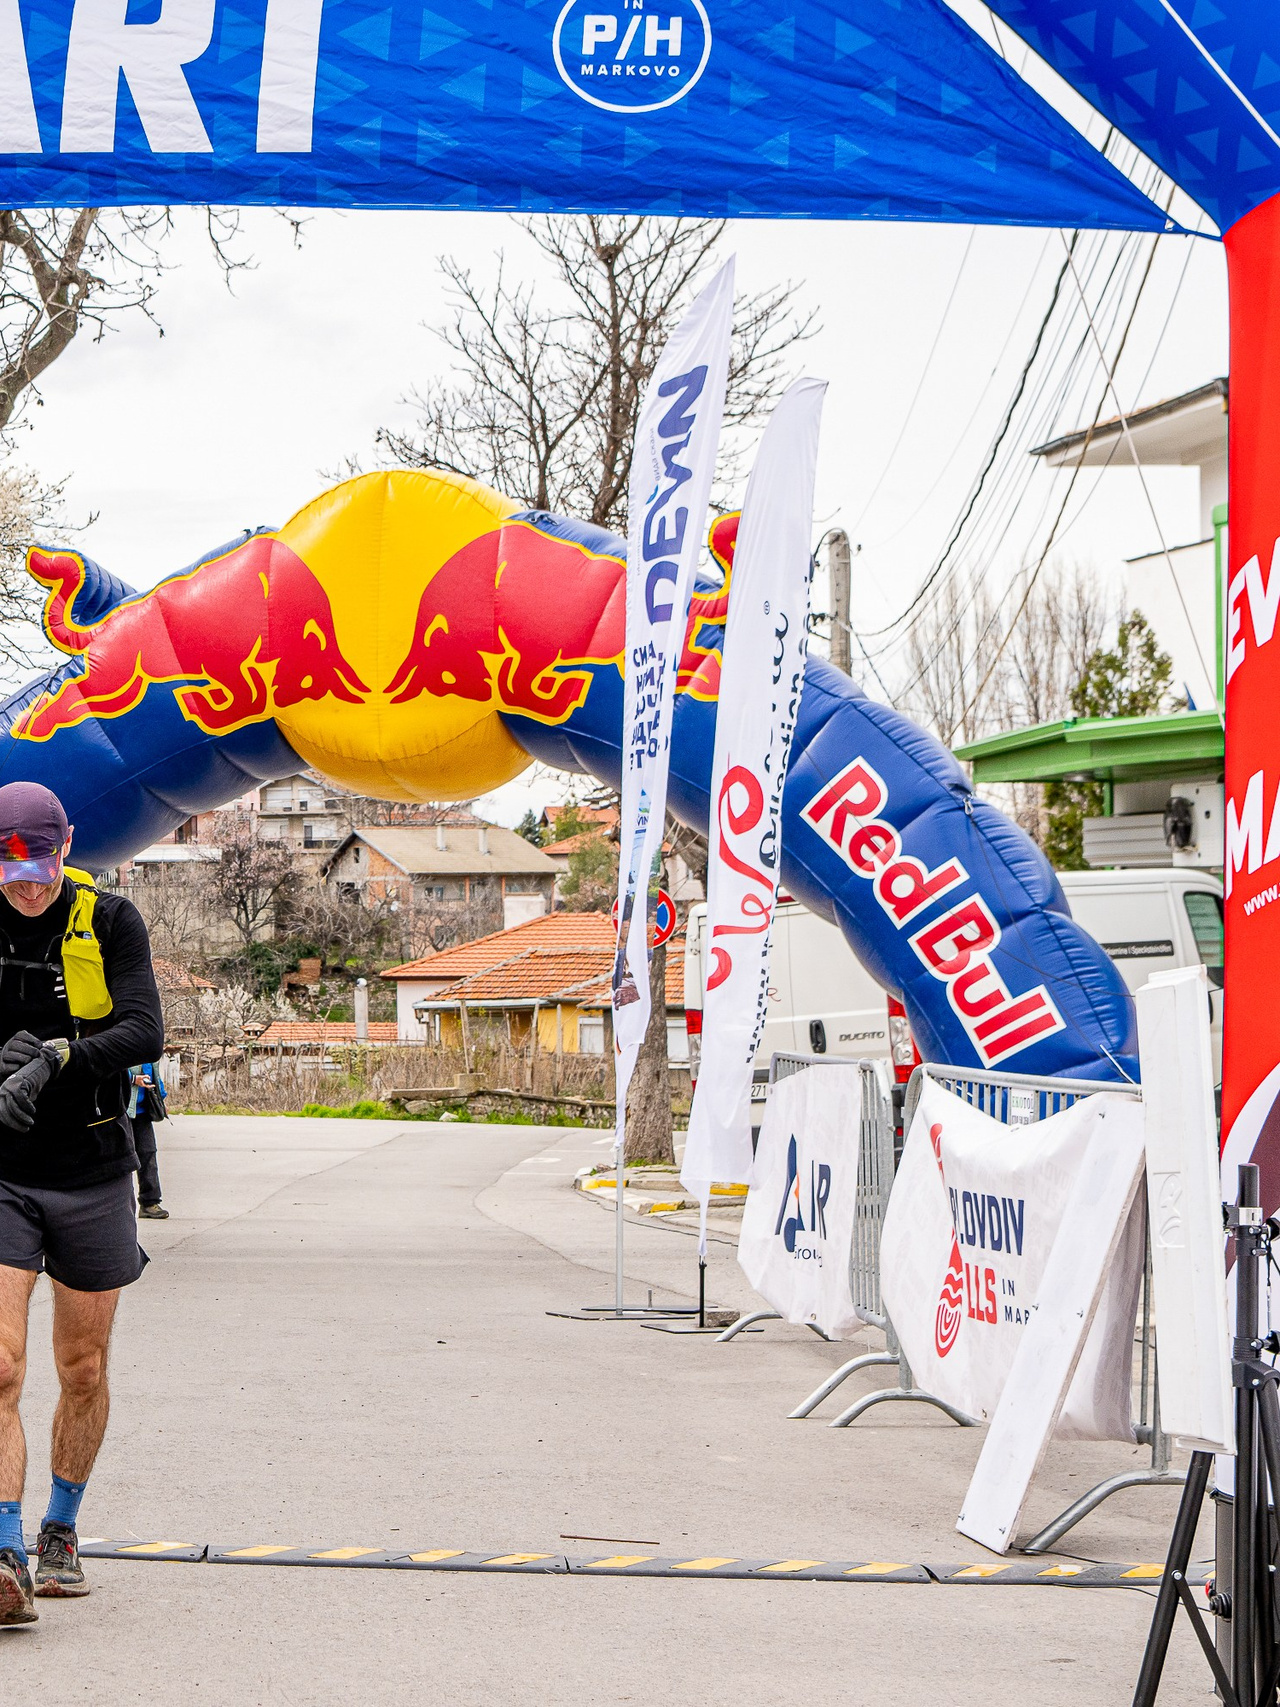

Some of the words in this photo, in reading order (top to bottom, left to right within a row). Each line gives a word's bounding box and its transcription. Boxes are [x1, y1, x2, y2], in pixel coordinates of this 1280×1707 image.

[624, 0, 643, 10] IN
[582, 14, 682, 60] P/H
[581, 64, 680, 77] MARKOVO
[803, 760, 966, 926] Red
[911, 896, 1062, 1065] Bull
[839, 1030, 885, 1042] DUCATO
[1002, 1278, 1016, 1297] IN
